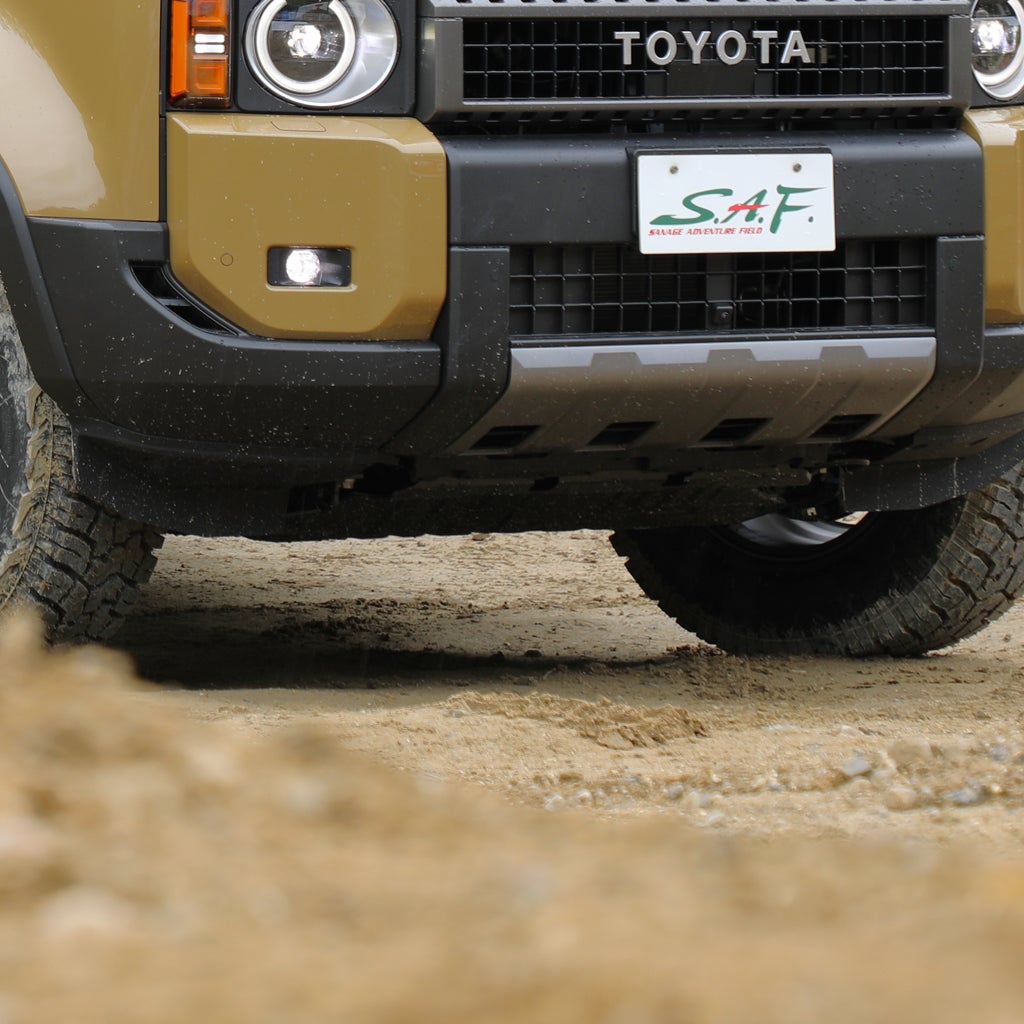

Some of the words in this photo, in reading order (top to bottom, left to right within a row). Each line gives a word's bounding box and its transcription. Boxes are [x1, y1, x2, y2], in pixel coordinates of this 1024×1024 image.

[614, 30, 812, 66] TOYOTA
[649, 184, 826, 234] S.A.F.
[648, 227, 683, 236] SANAGE
[686, 227, 736, 236] ADVENTURE
[738, 226, 763, 235] FIELD
